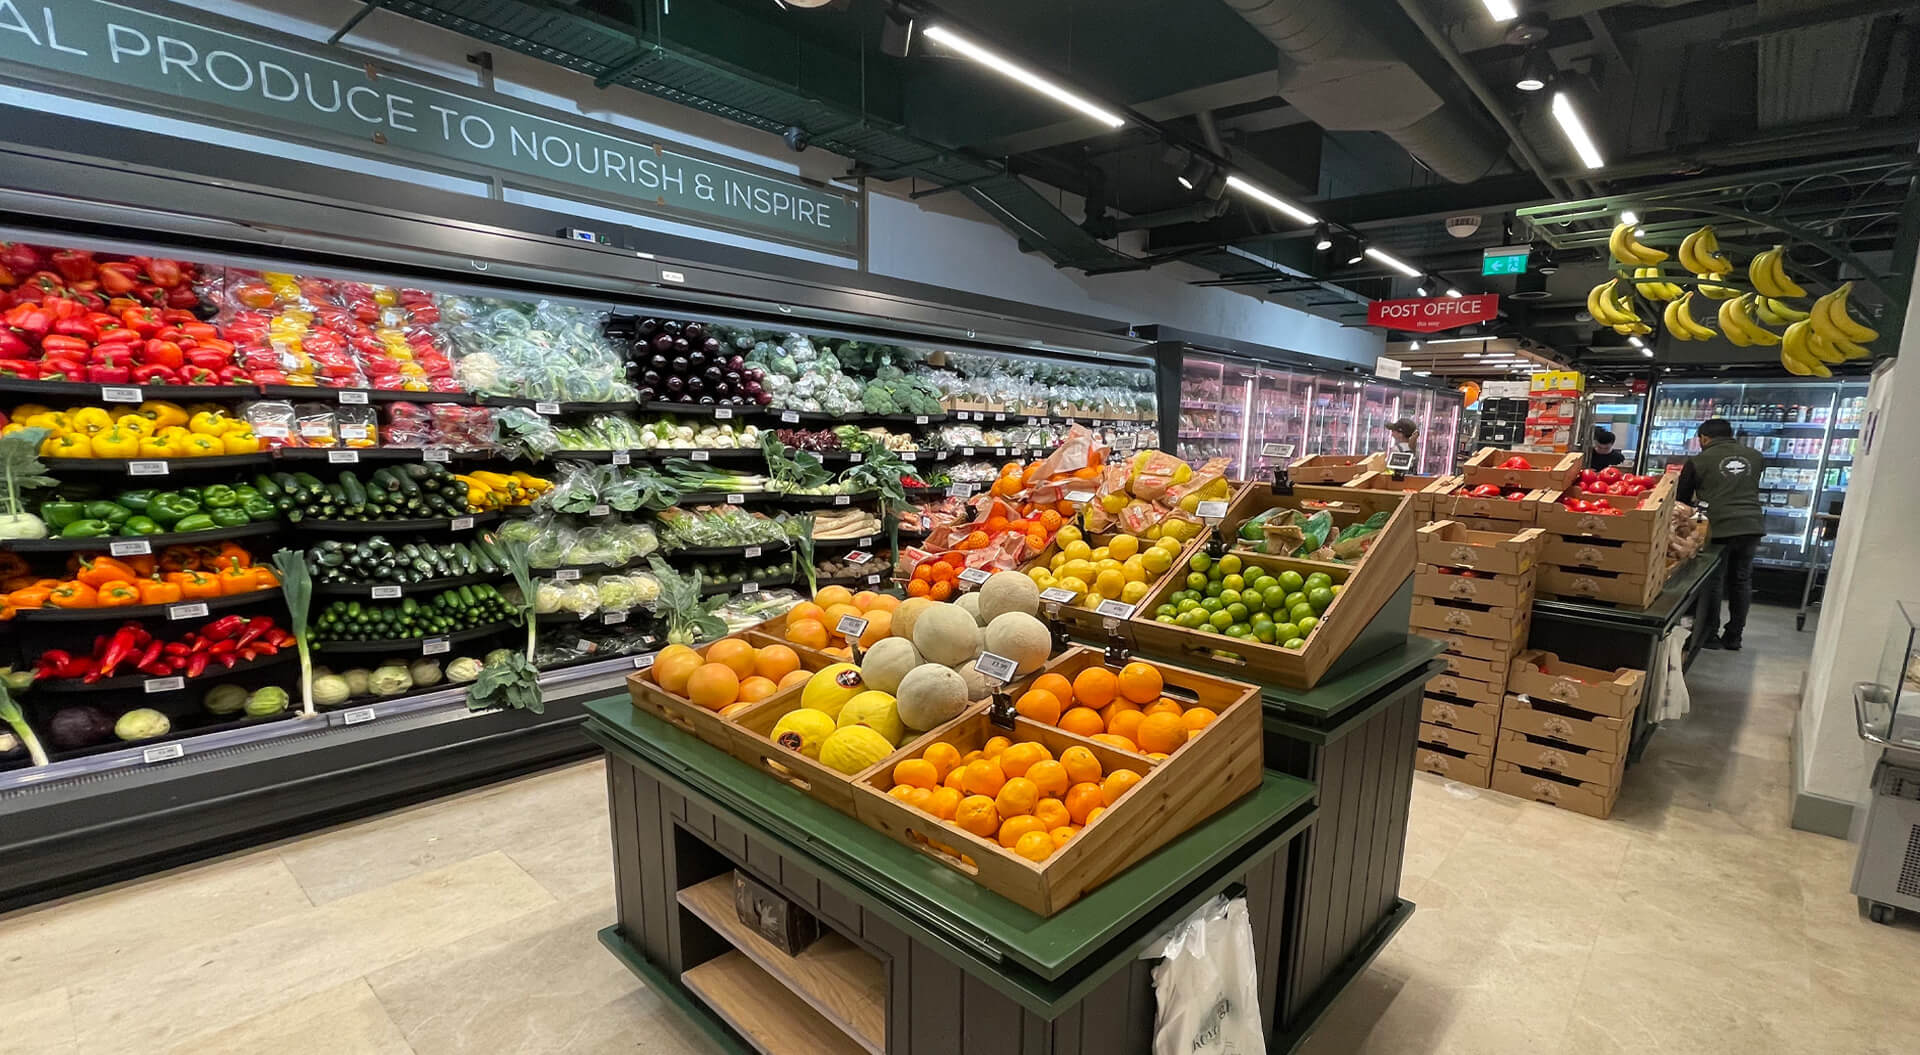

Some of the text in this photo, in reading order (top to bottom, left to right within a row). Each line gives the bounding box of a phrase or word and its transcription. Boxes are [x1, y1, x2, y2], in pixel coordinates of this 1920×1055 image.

[0, 0, 832, 228] AL PRODUCE TO NOURISH & INSPIRE
[1381, 300, 1481, 318] POST OFFICE
